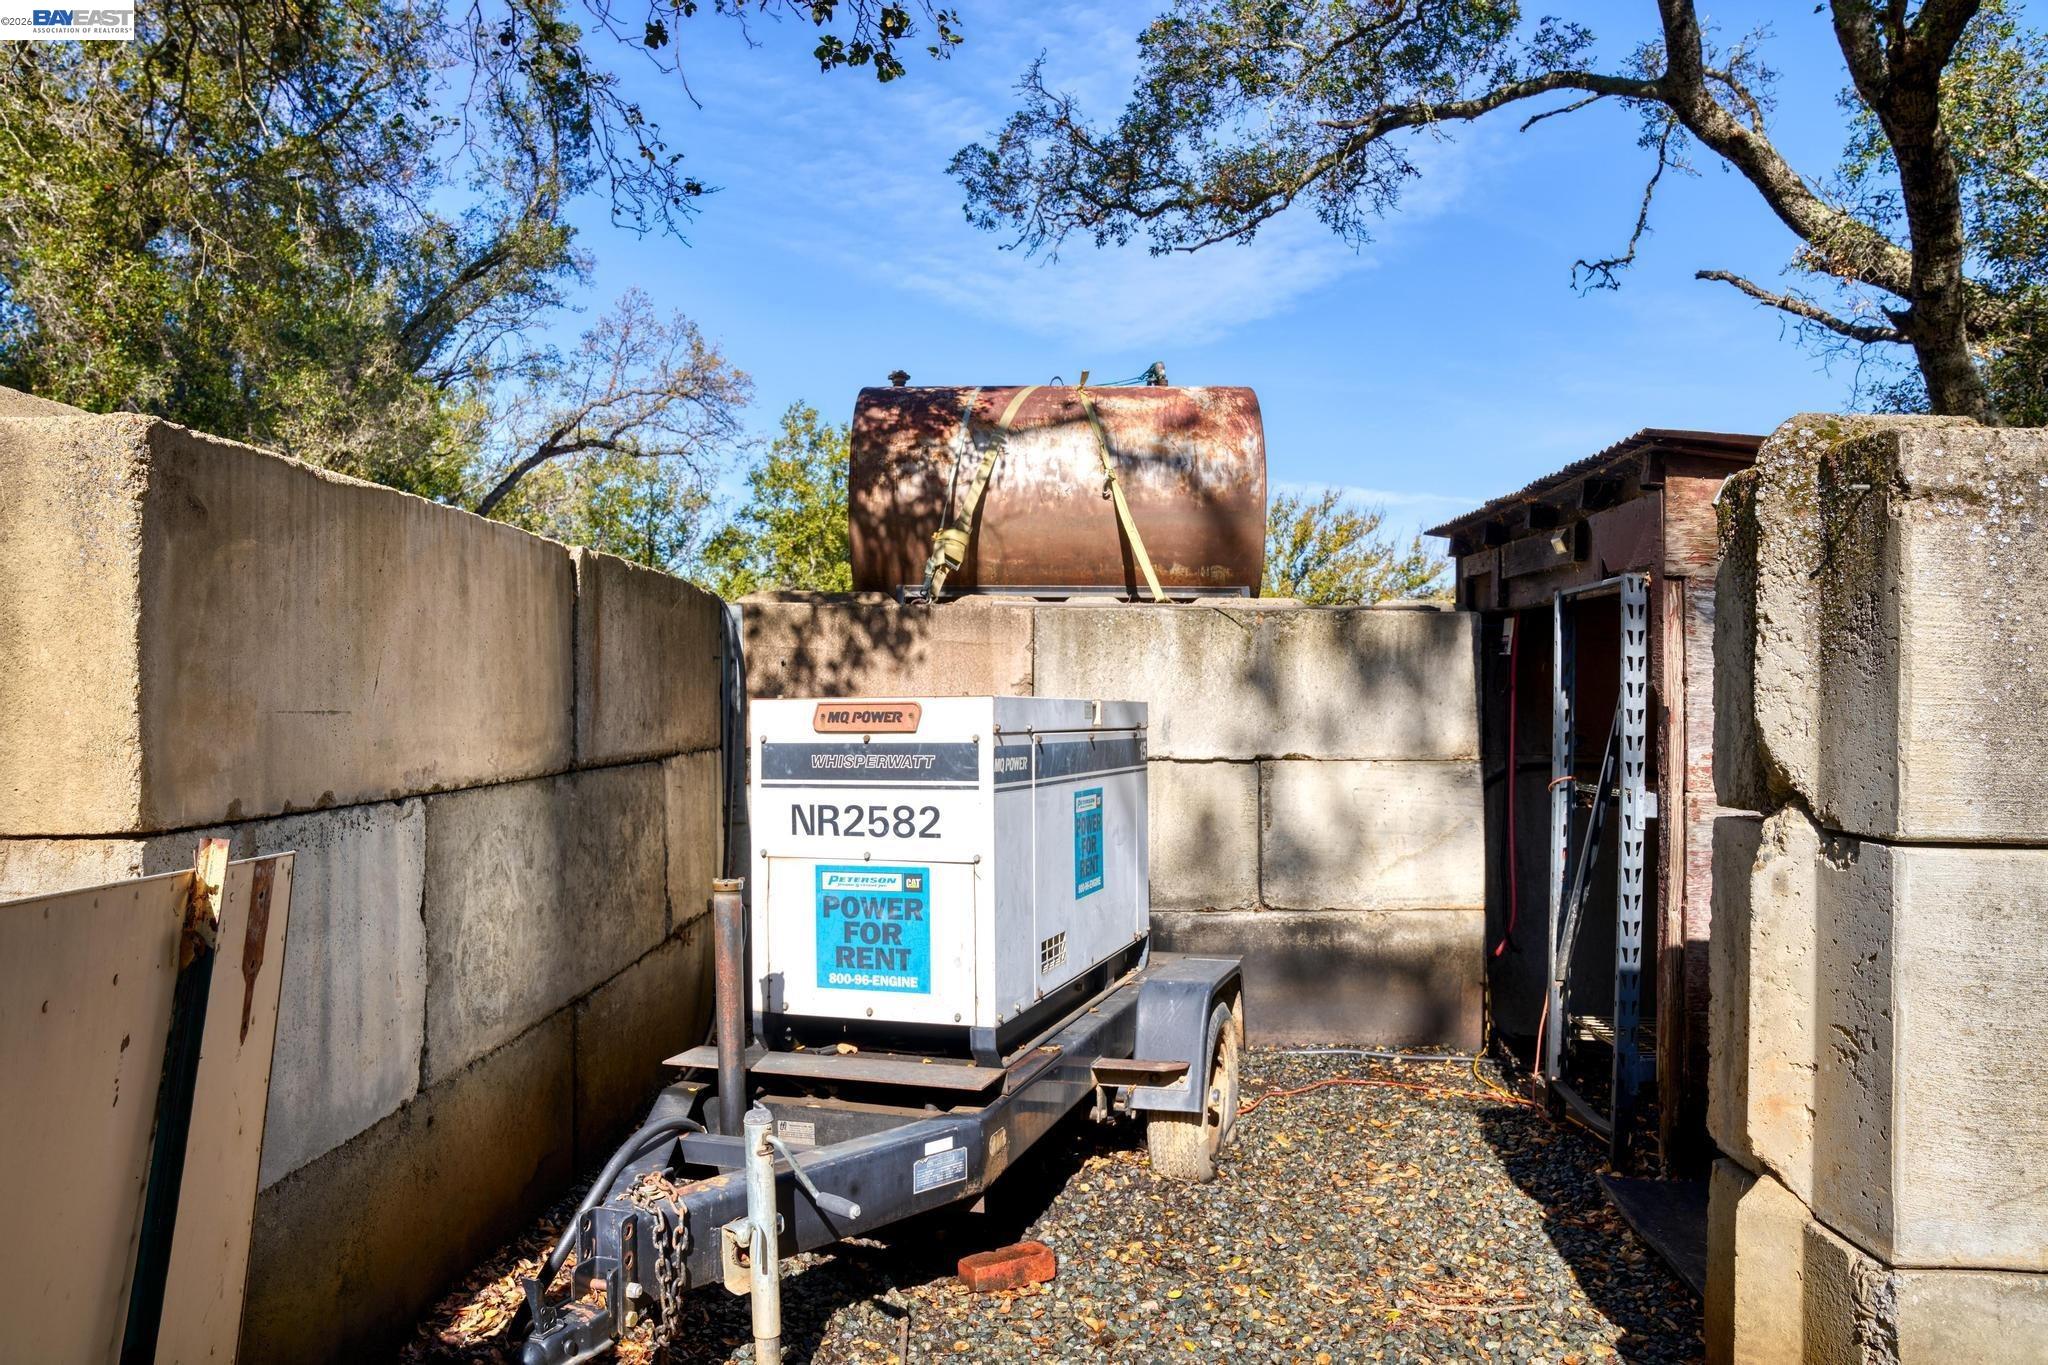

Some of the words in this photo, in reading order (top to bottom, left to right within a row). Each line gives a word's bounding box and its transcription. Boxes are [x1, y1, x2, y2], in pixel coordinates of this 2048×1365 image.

[827, 710, 850, 725] MQ
[851, 710, 904, 724] POWER
[811, 754, 936, 769] WHISPERWATT
[994, 757, 1005, 774] MQ
[1005, 756, 1028, 772] POWER
[791, 803, 942, 839] NR2582
[1080, 853, 1099, 878] RENT
[905, 878, 921, 889] CAT
[822, 895, 924, 922] POWER
[843, 921, 903, 946] FOR
[835, 945, 913, 972] RENT
[828, 972, 919, 989] 800-96-ENGINE
